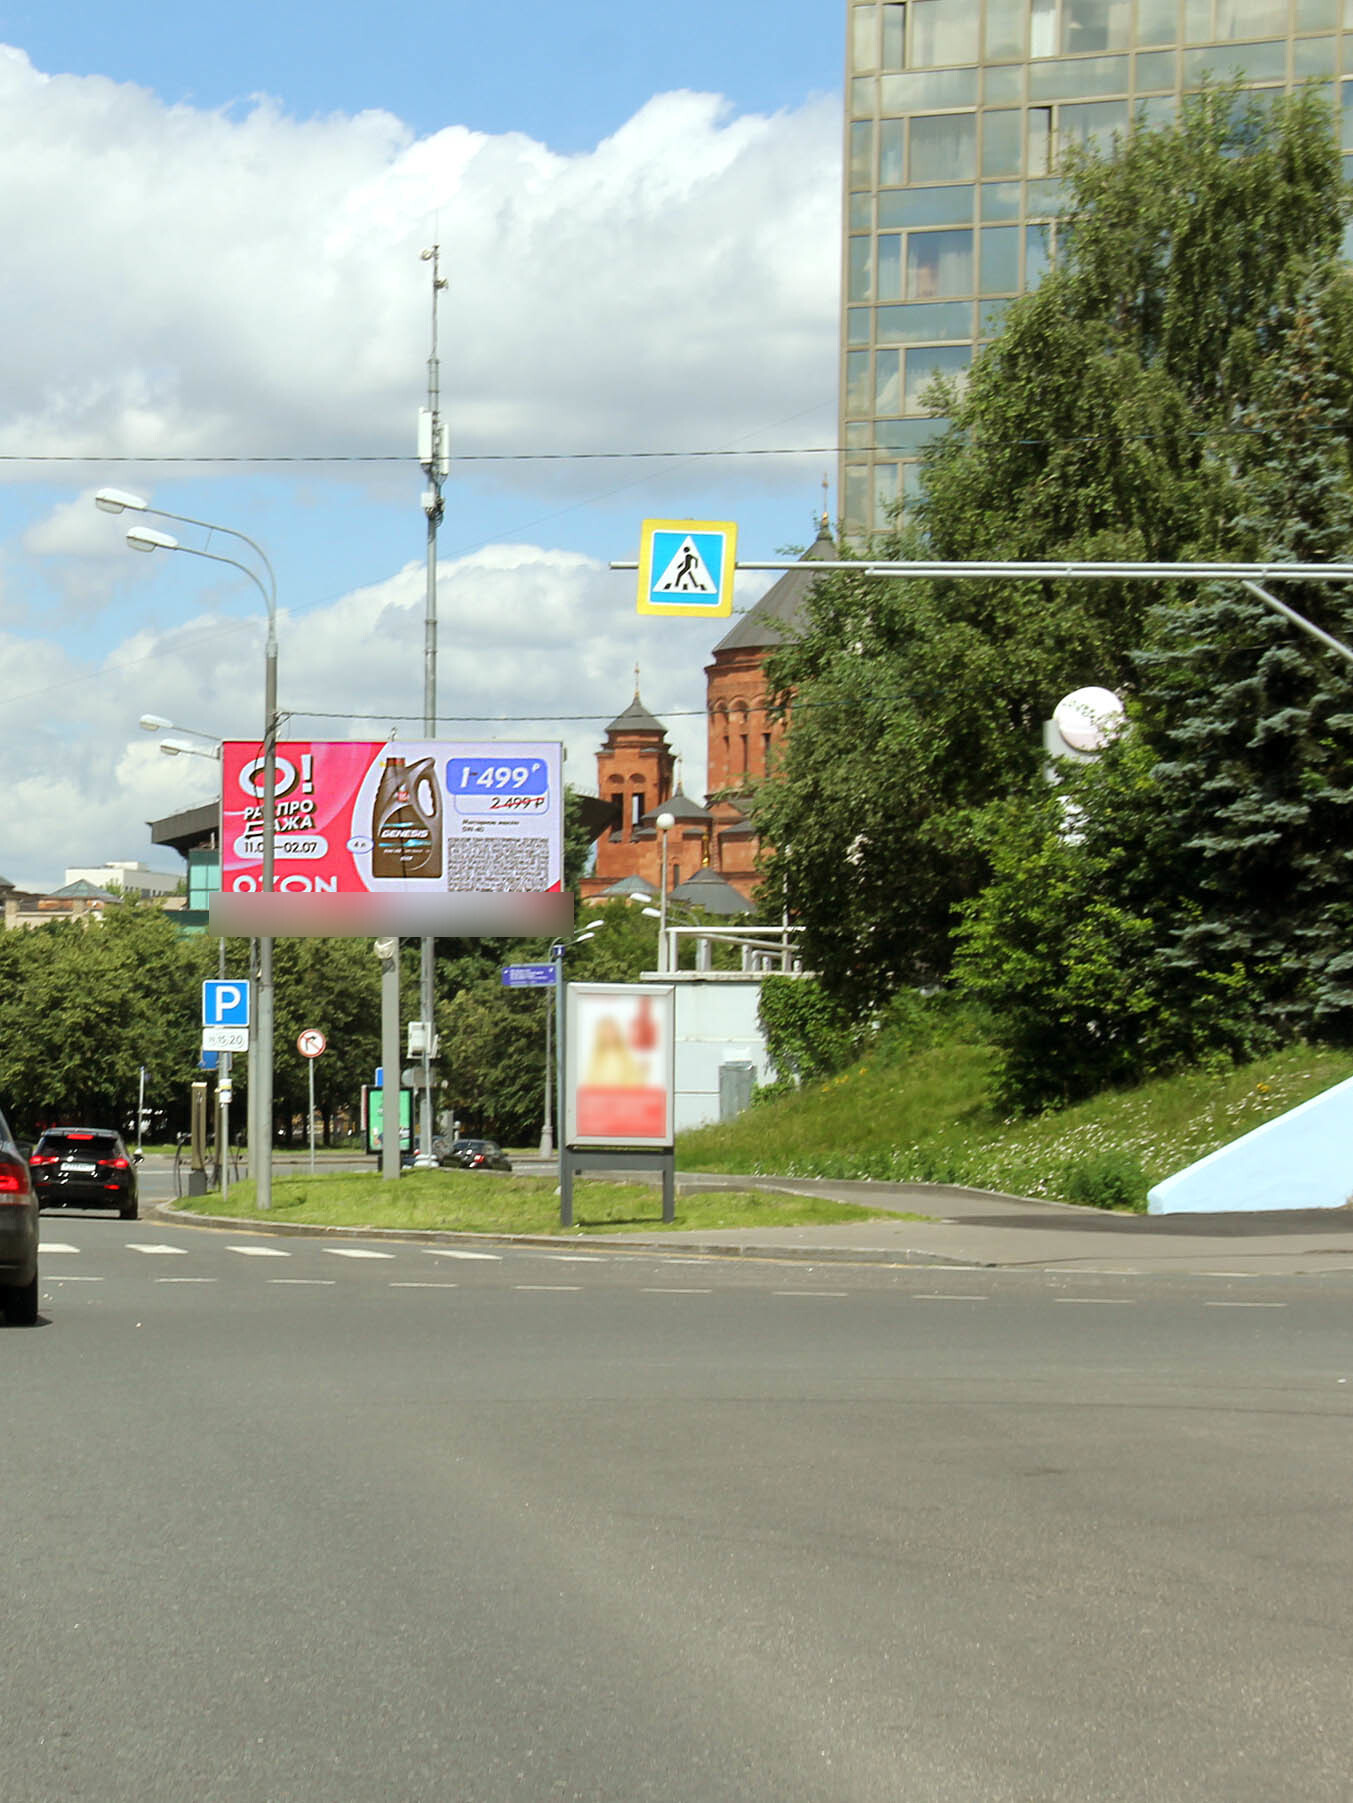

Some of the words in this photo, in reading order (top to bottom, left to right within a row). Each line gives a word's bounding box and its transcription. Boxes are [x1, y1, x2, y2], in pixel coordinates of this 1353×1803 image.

[243, 799, 315, 821] РАПРО
[232, 874, 338, 892] OON
[216, 985, 241, 1022] P
